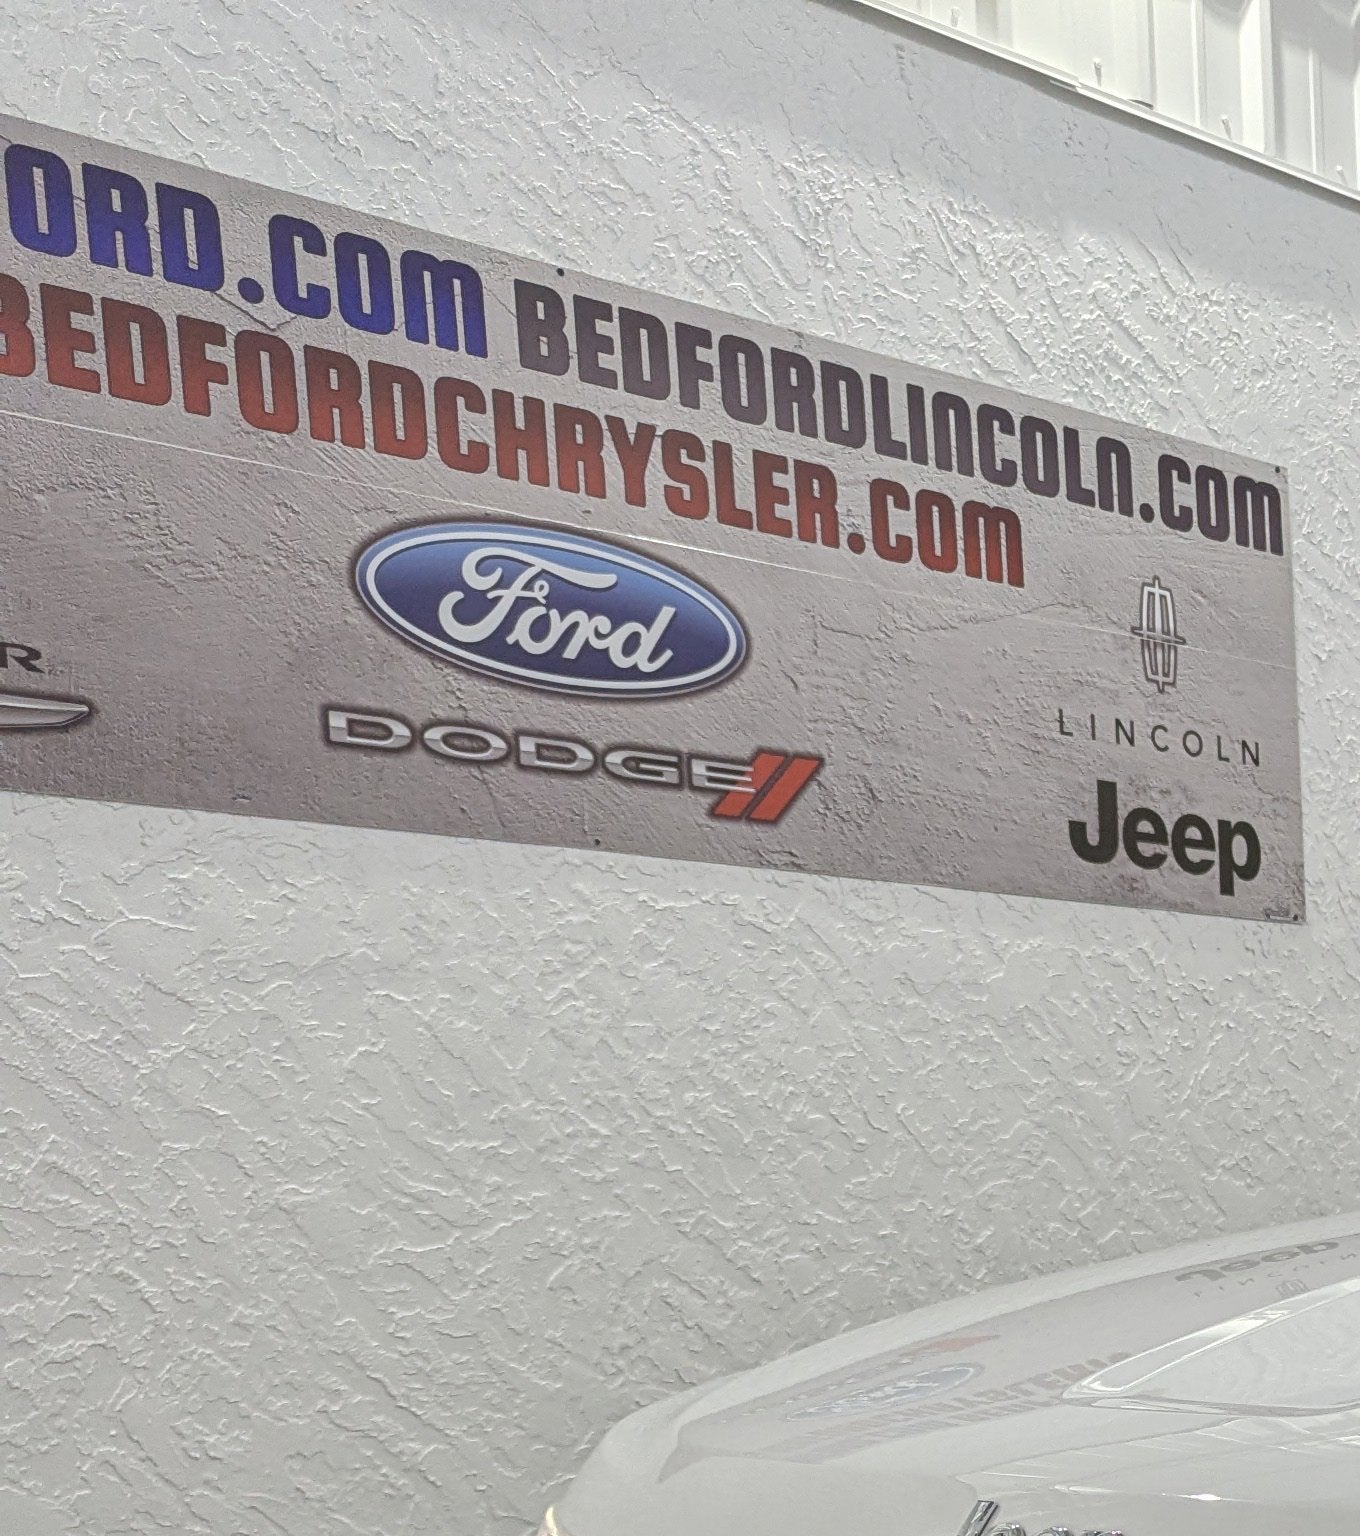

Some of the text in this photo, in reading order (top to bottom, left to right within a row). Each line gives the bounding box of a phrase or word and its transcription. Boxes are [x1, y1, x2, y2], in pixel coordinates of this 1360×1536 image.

[435, 546, 676, 673] Ford
[328, 710, 756, 793] DODGE
[1057, 708, 1260, 767] LINCOLN
[1068, 779, 1261, 897] Jeep
